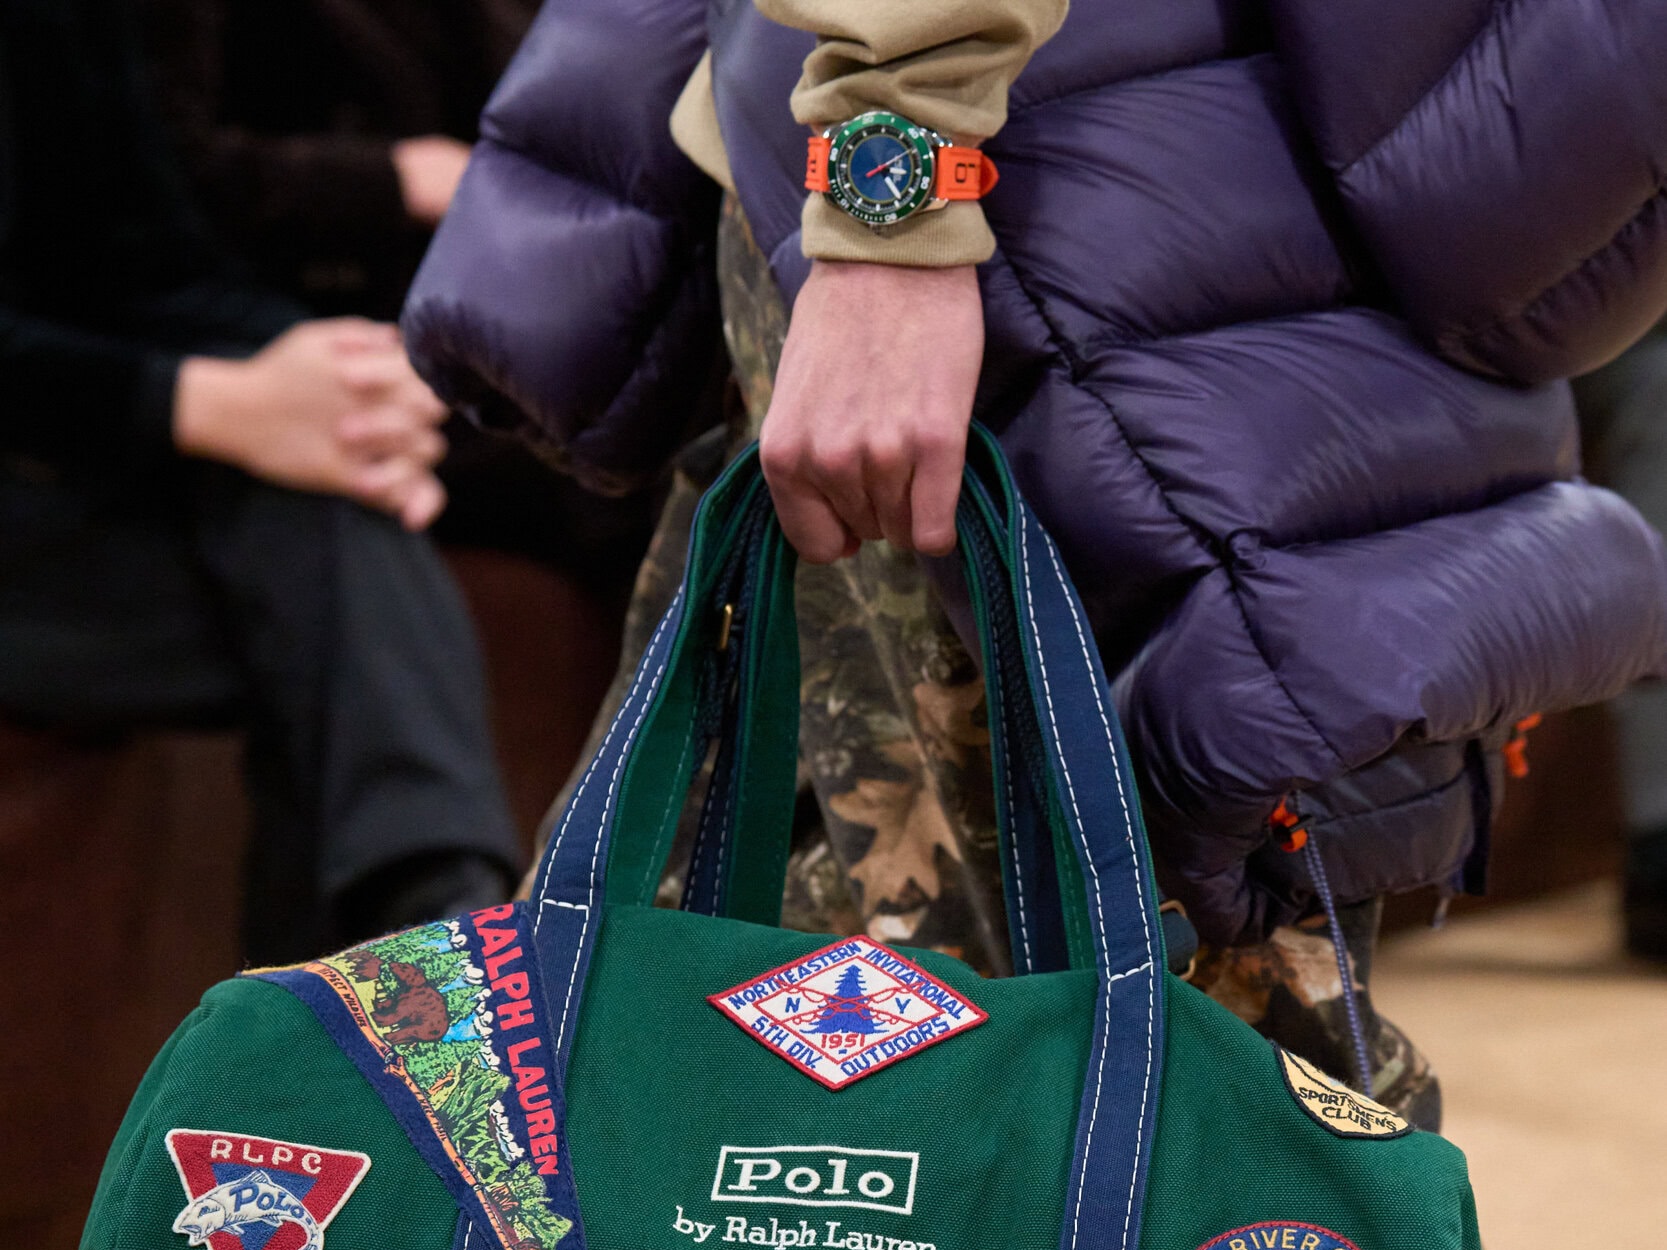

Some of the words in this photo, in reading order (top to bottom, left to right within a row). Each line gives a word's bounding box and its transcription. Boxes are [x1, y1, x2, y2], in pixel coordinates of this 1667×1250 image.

[727, 941, 863, 1010] NORTHEASTERN
[865, 948, 968, 1021] INVITATIONAL
[784, 996, 801, 1013] N
[894, 997, 912, 1014] Y
[469, 903, 535, 1031] RALPH
[507, 1037, 559, 1175] LAUREN
[789, 1040, 823, 1070] DIV.
[821, 1033, 867, 1049] 1951
[840, 1016, 951, 1077] OUTDOORS
[1298, 1086, 1398, 1133] SPORTSMEN'S
[1321, 1106, 1372, 1131] CLUB
[728, 1158, 894, 1198] Polo
[672, 1205, 716, 1243] by
[722, 1215, 818, 1250] Ralph
